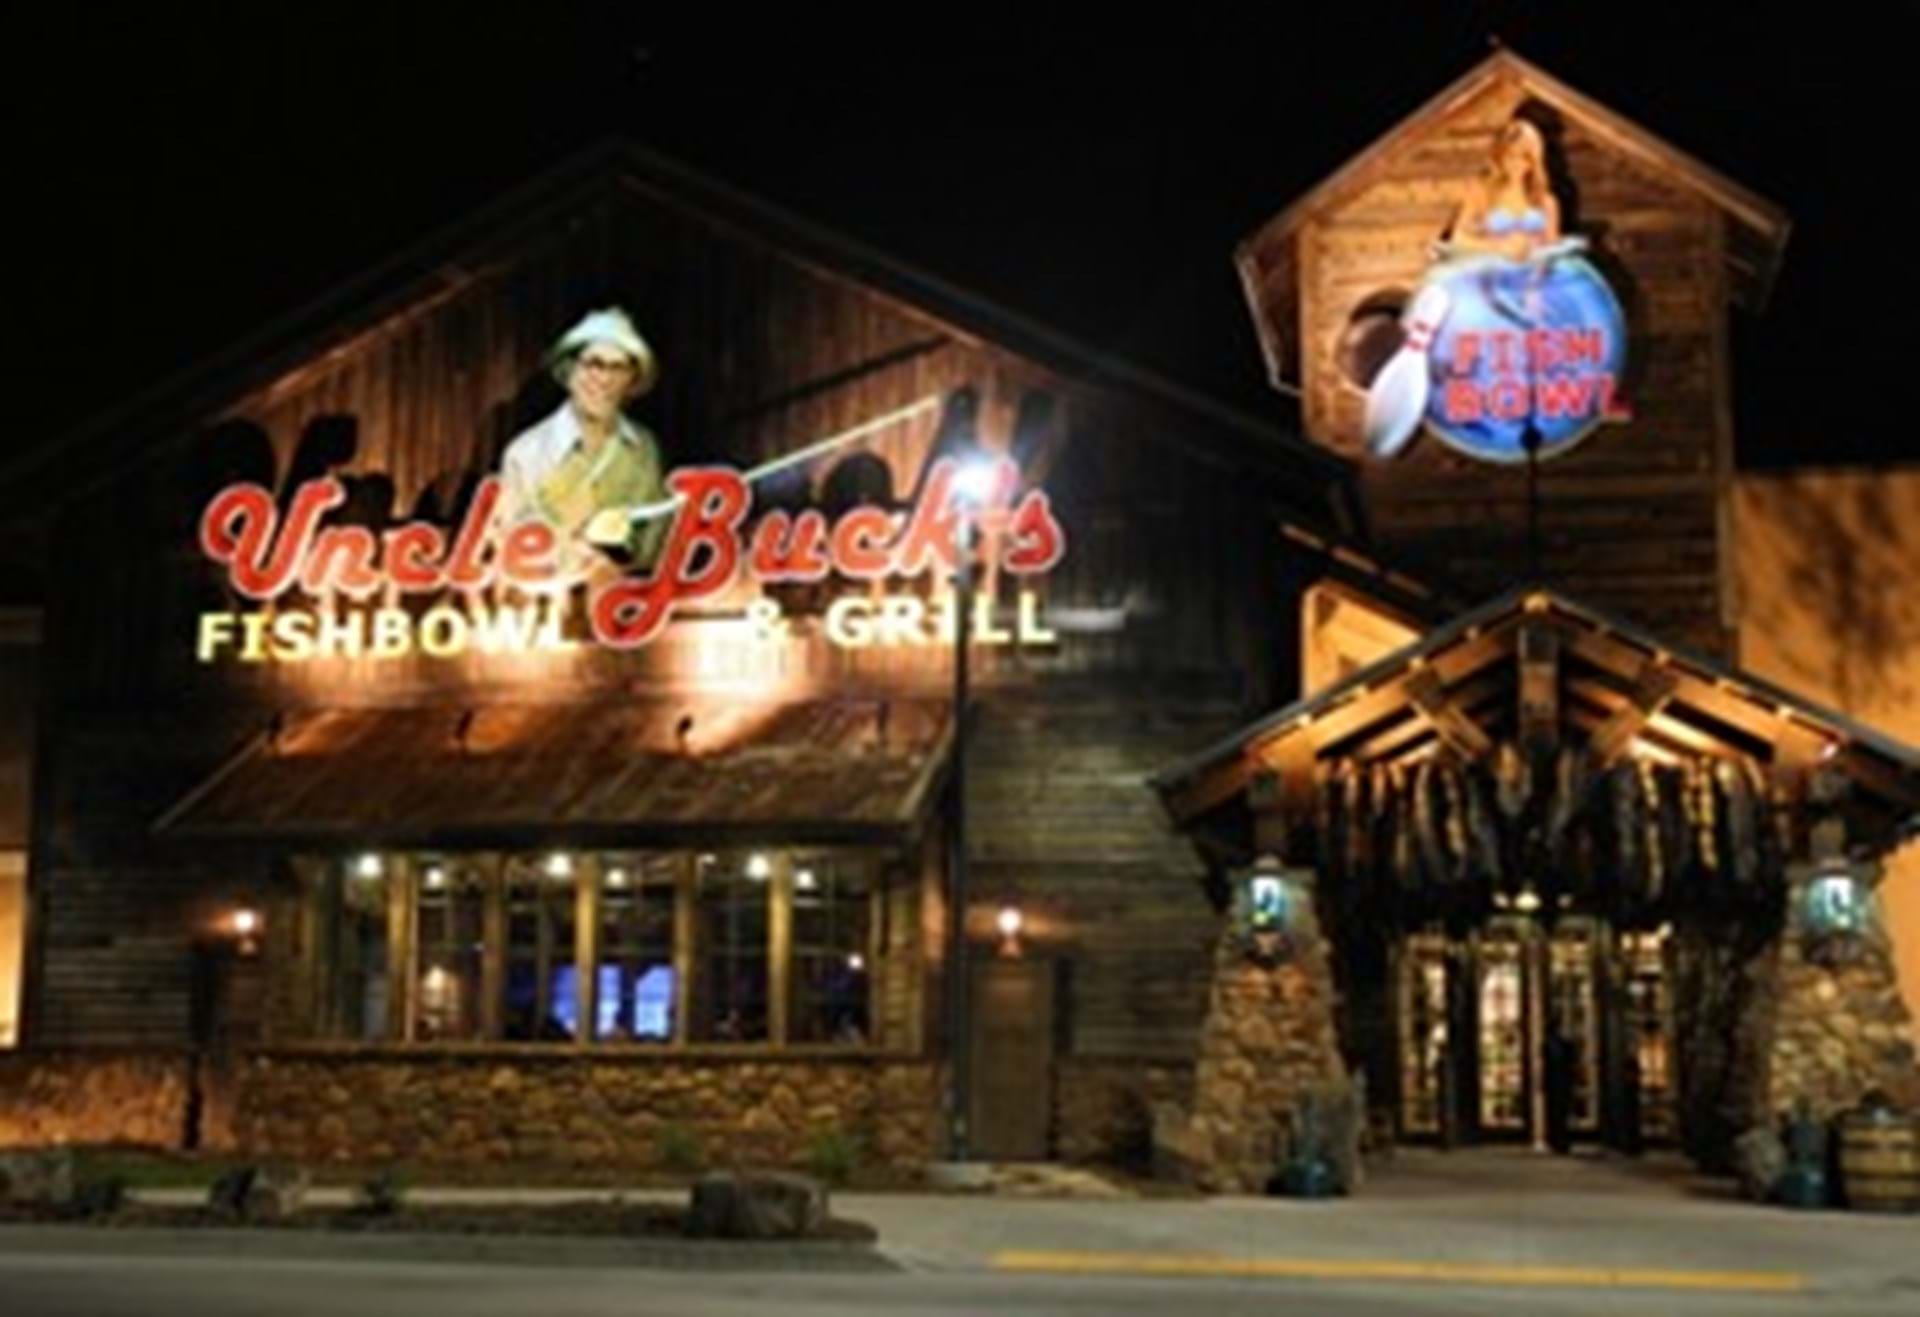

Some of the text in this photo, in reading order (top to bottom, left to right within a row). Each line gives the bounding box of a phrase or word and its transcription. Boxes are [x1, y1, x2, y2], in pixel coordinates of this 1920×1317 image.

[1454, 328, 1603, 374] FISH
[1445, 372, 1631, 422] BOWL
[202, 456, 1064, 648] Uncle Buck's
[197, 592, 1056, 662] FISHBOWL & GRILL
